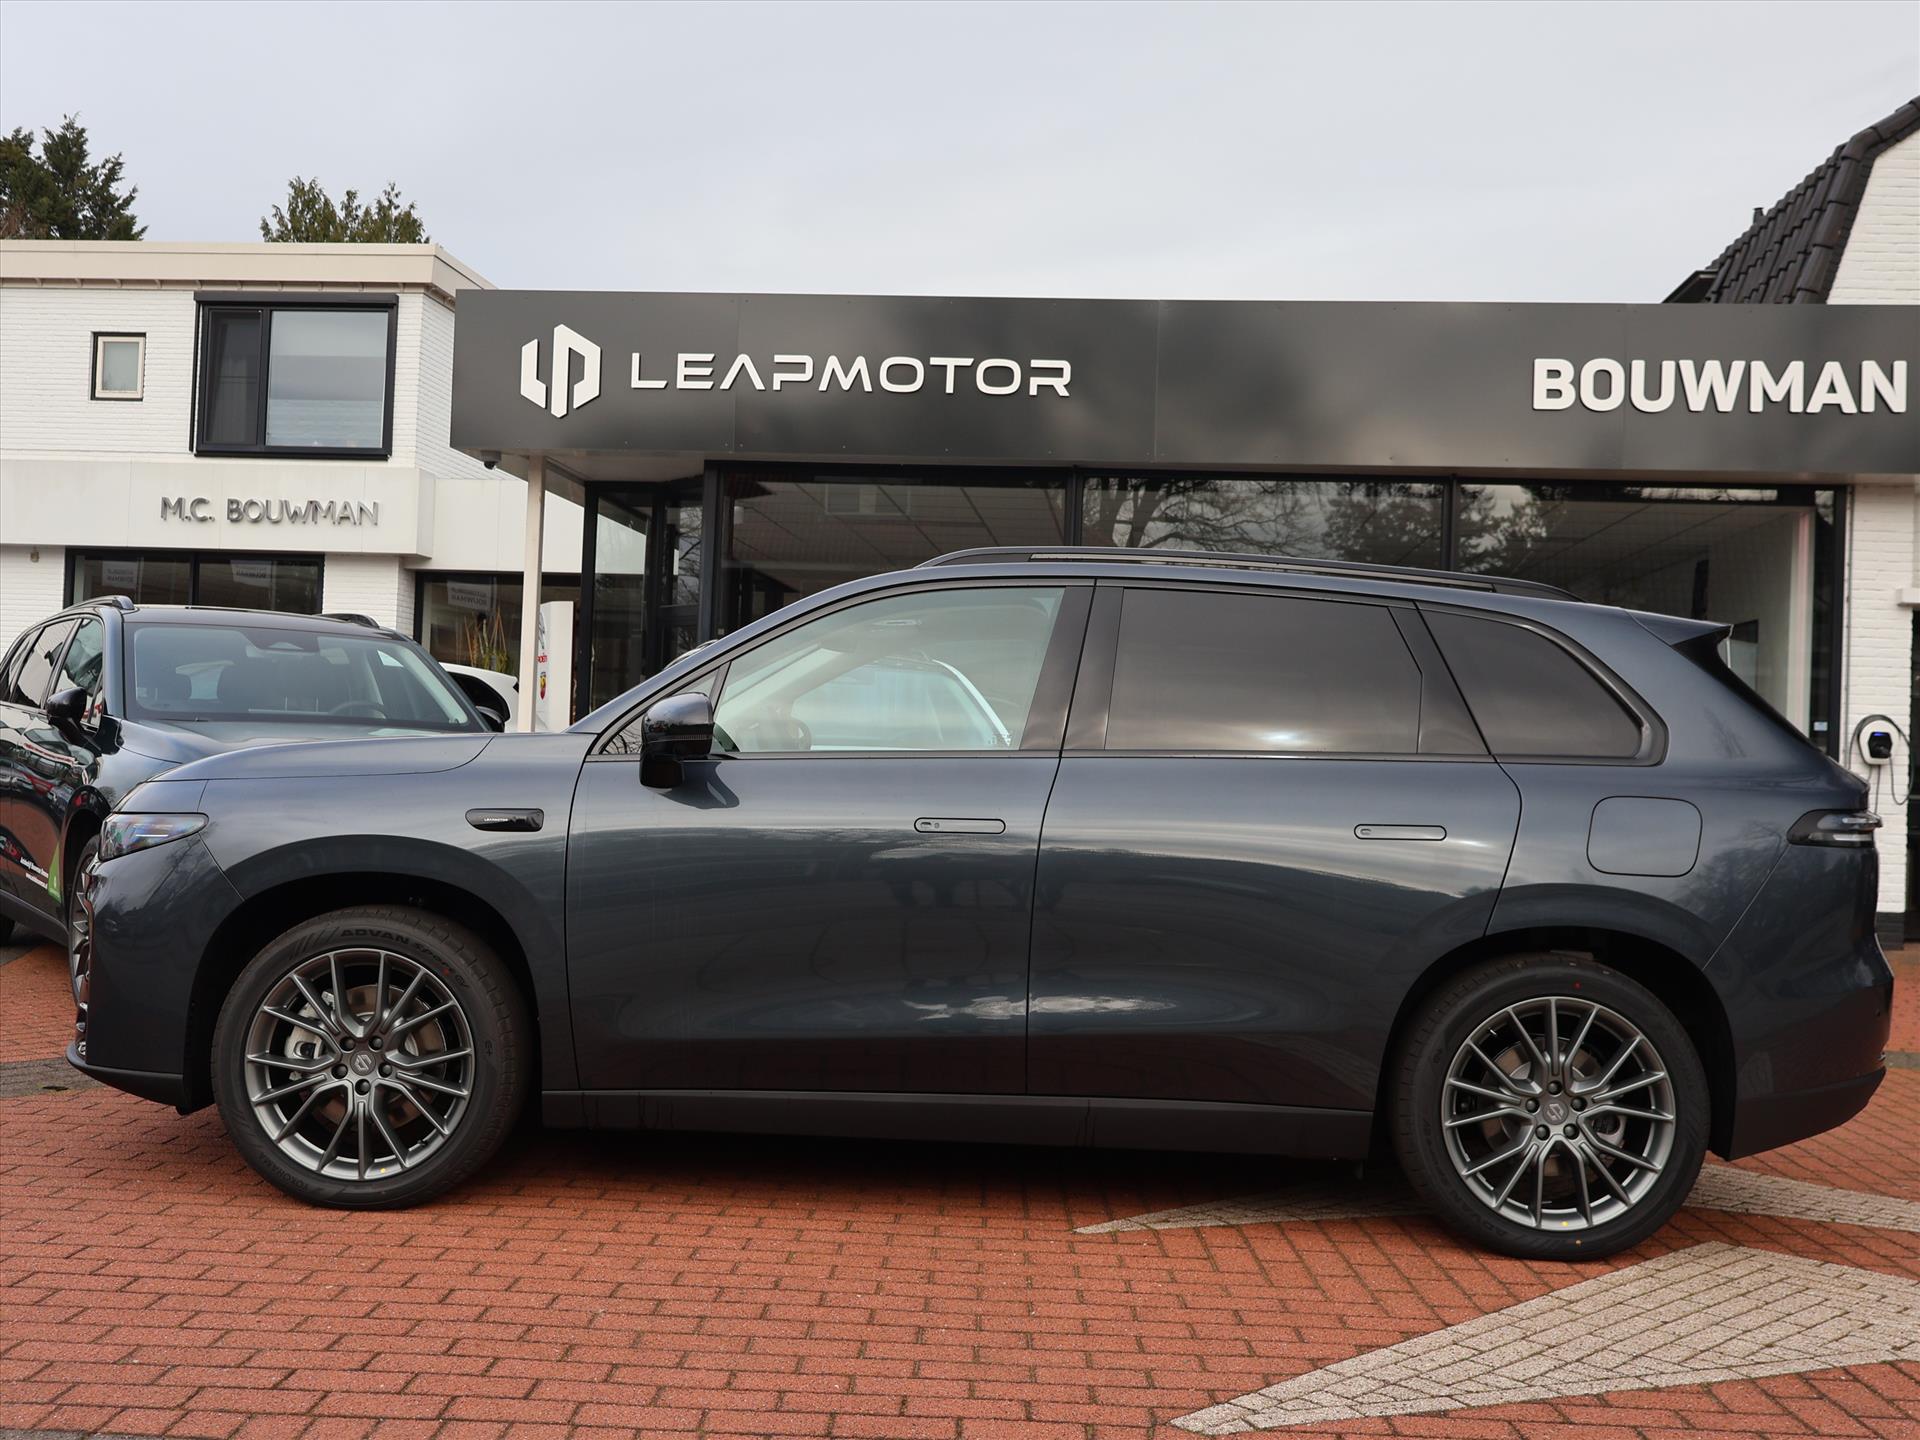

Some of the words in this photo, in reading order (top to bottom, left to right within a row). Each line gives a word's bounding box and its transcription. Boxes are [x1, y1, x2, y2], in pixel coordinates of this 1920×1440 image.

[630, 352, 1072, 397] LEAPMOTOR
[1533, 358, 1908, 414] BOUWMAN
[160, 497, 215, 522] M.C.
[226, 498, 379, 526] BOUWMAN
[339, 928, 410, 945] ADVAN
